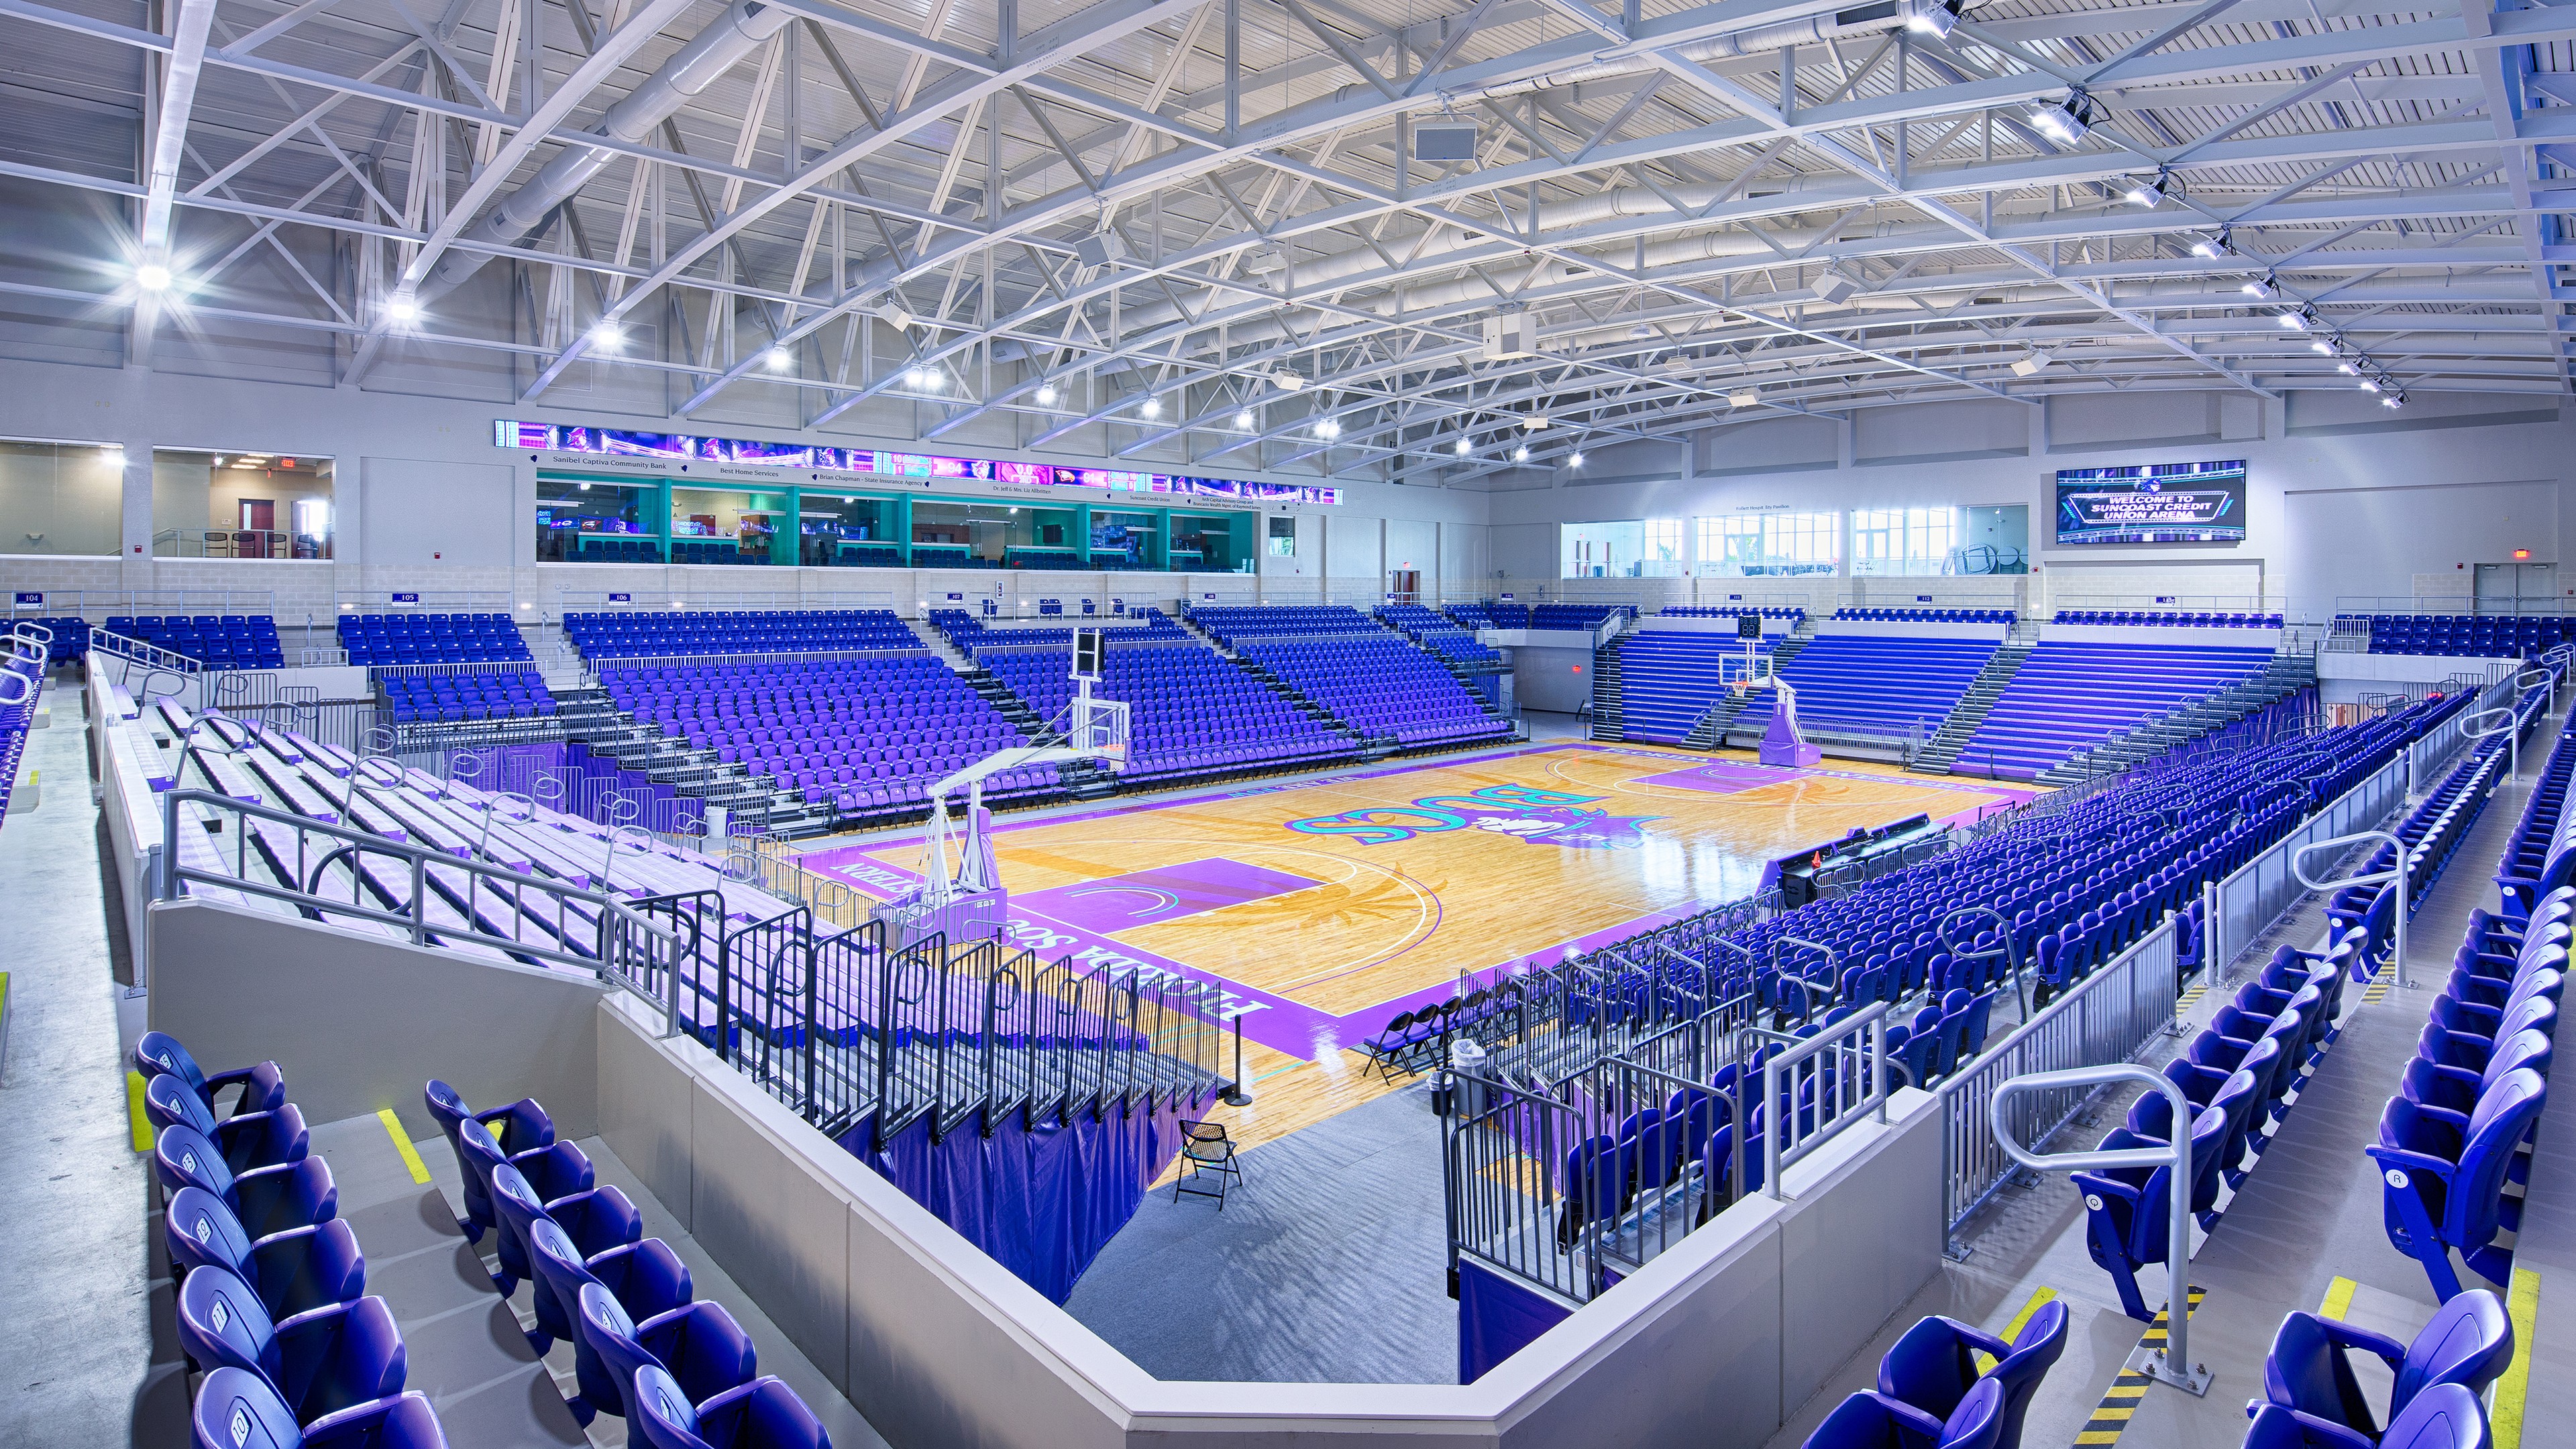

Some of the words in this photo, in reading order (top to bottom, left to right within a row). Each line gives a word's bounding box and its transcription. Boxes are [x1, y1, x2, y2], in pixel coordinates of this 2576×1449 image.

[610, 460, 649, 469] Community
[947, 462, 963, 474] 94
[1083, 472, 1095, 484] 91
[2091, 503, 2163, 513] SUNCOAST
[2164, 502, 2212, 511] CREDIT
[2103, 511, 2147, 519] UNION
[2149, 511, 2195, 519] ARENA
[1599, 747, 1711, 763] FLORIDA
[1283, 783, 1614, 846] BUCS
[183, 1157, 193, 1171] 13
[2394, 1174, 2401, 1183] R
[2090, 1198, 2098, 1208] Q
[197, 1223, 209, 1240] 12
[213, 1307, 225, 1327] 11
[233, 1417, 246, 1441] 10
